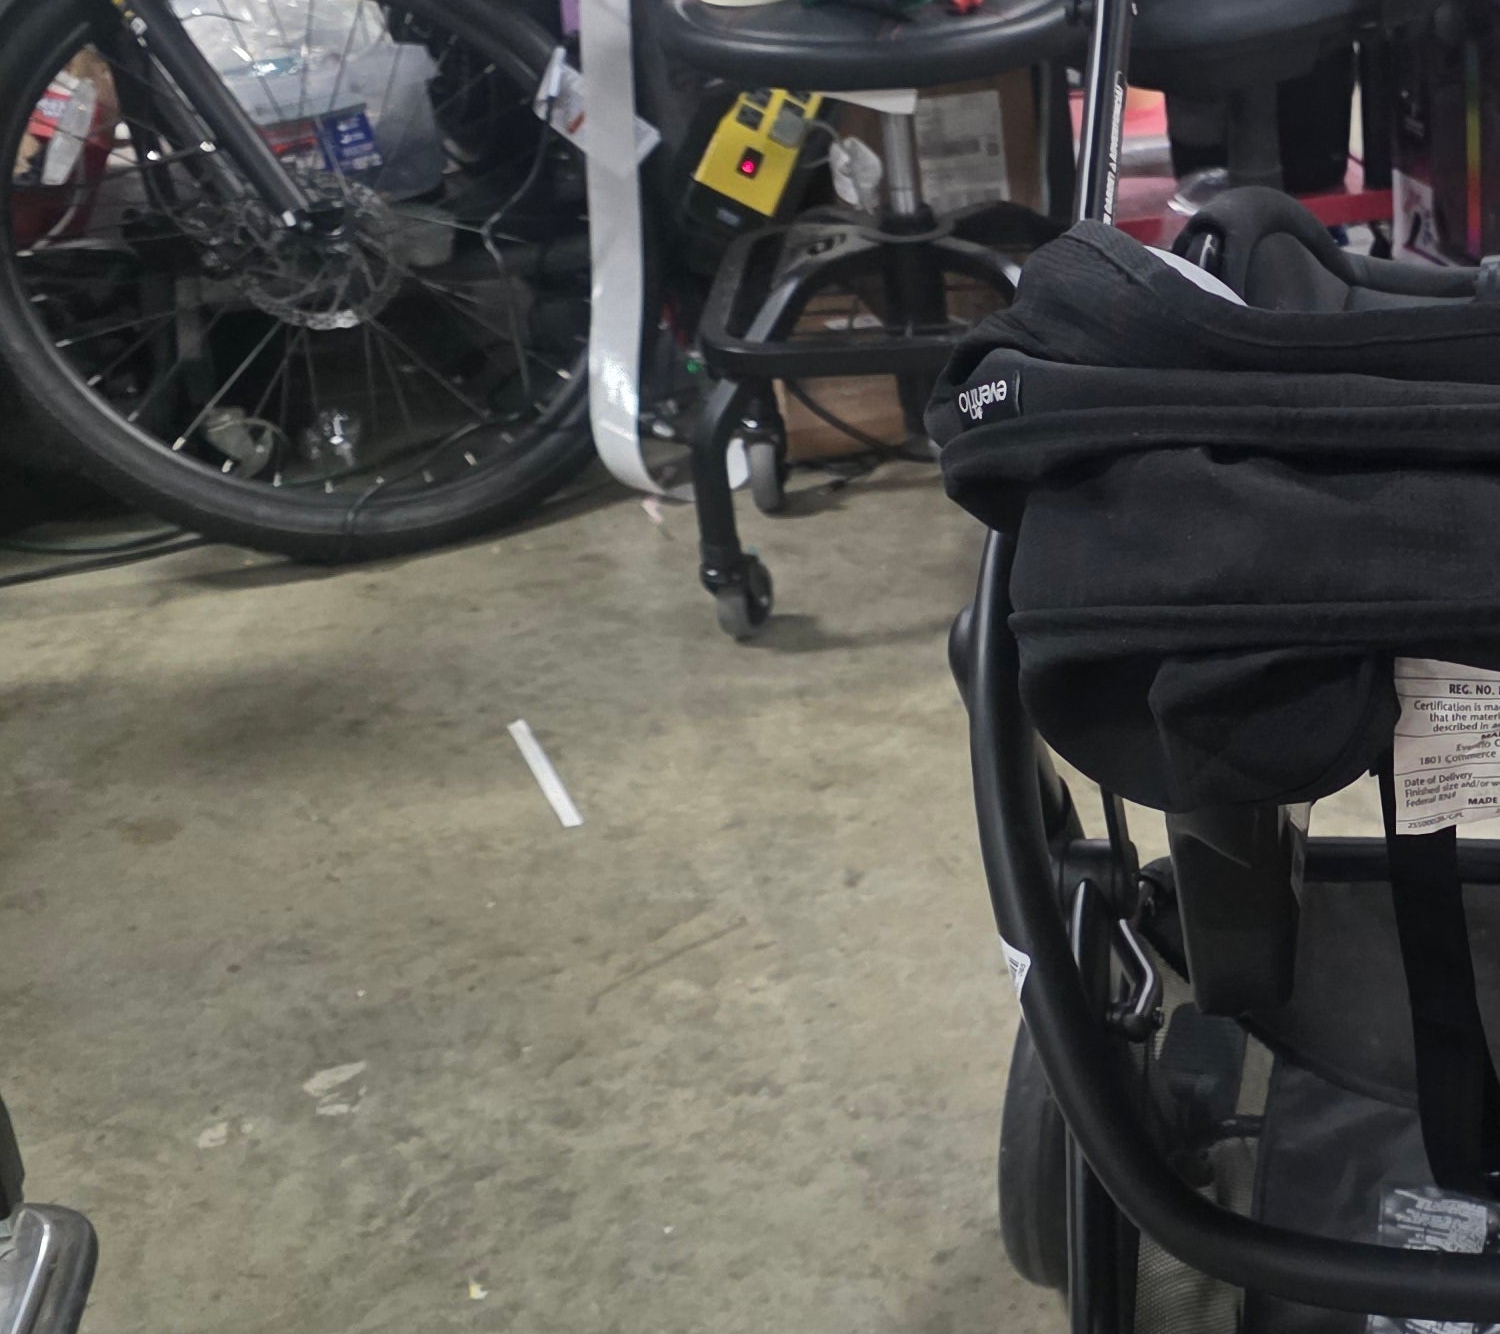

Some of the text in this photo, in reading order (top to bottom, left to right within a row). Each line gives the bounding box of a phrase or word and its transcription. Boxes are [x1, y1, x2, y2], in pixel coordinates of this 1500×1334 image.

[958, 379, 1008, 420] evenflo
[1449, 683, 1473, 695] REG.
[1475, 684, 1495, 696] NO.
[1413, 700, 1472, 712] Certification
[1474, 702, 1482, 711] is
[1429, 713, 1449, 722] that
[1451, 712, 1467, 722] the
[1433, 722, 1478, 733] described
[1479, 722, 1489, 730] in
[1420, 756, 1442, 765] 1801
[1444, 749, 1497, 764] Commerce
[1404, 771, 1473, 788] Date of Delivery
[1404, 785, 1441, 798] Finished
[1442, 782, 1459, 793] size
[1460, 778, 1489, 789] and/or
[1405, 793, 1437, 808] Federal
[1467, 794, 1498, 806] MADE
